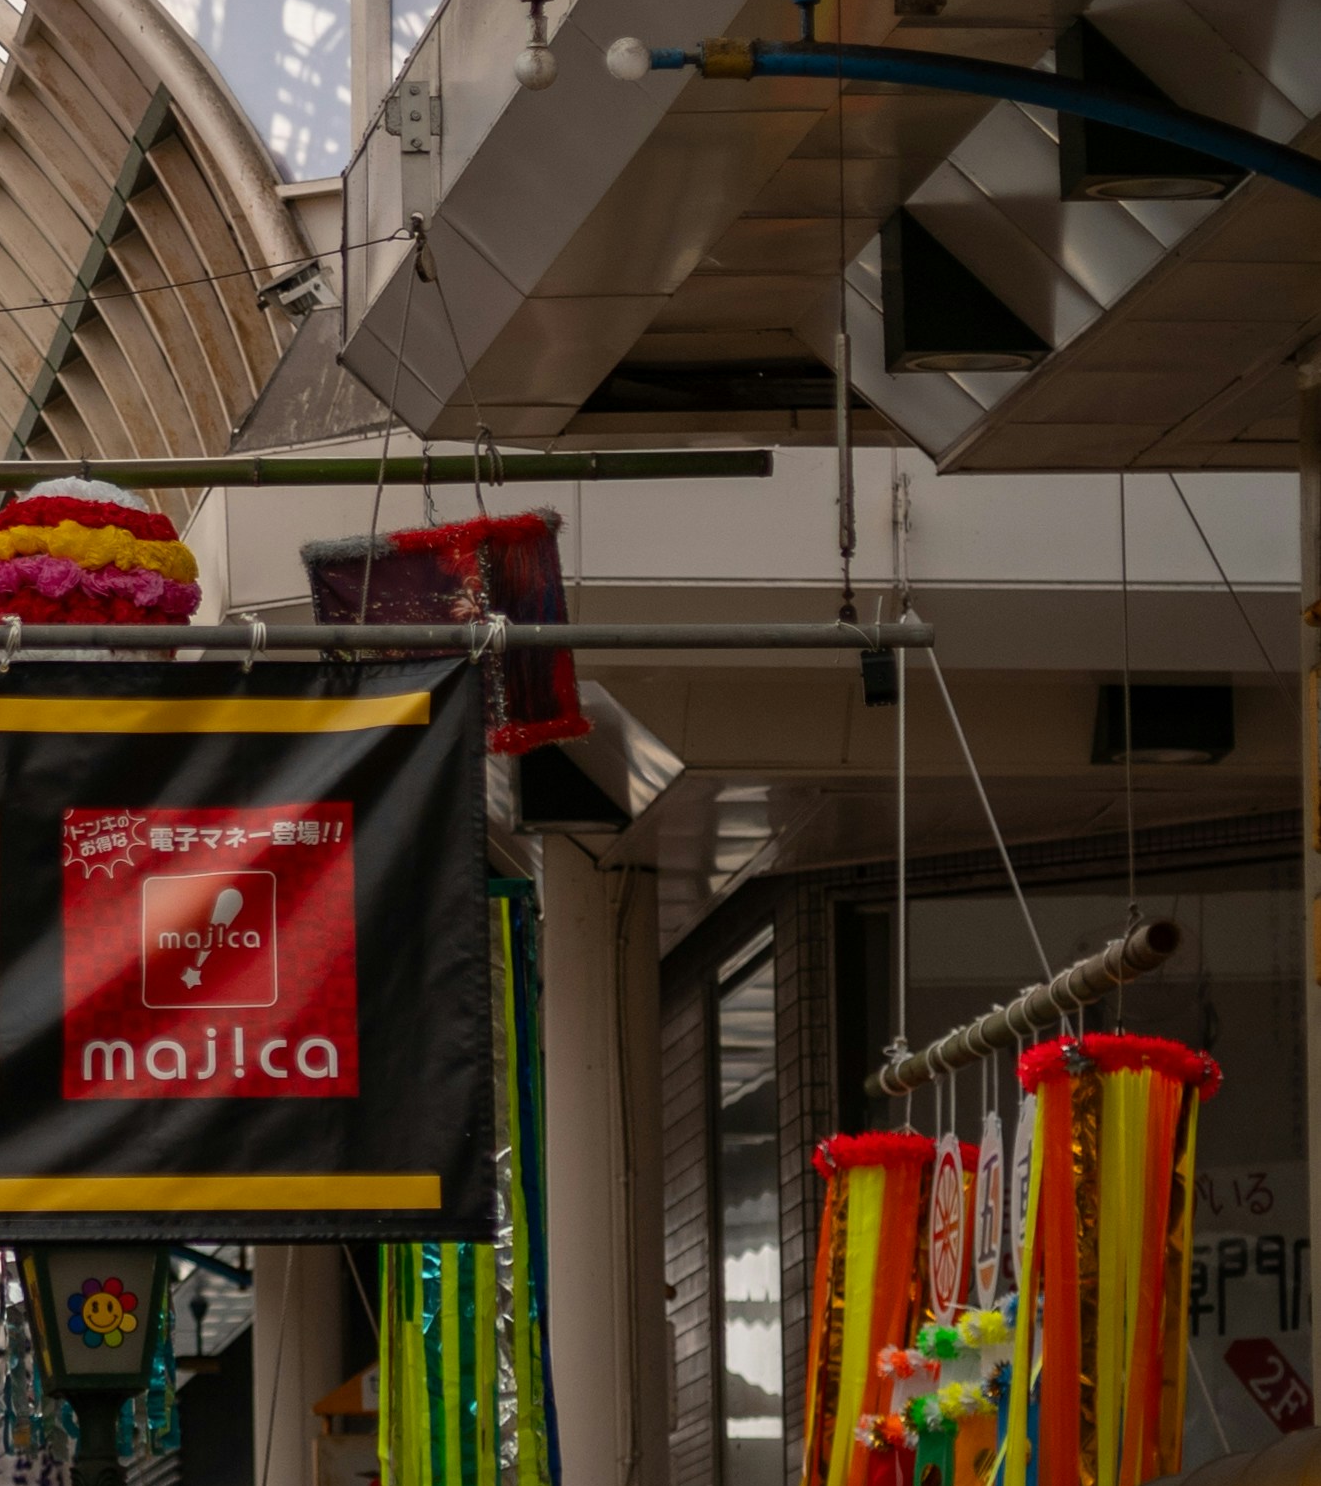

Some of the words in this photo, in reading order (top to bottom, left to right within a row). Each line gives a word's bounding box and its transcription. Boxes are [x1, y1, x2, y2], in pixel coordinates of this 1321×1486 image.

[69, 815, 130, 841] ドンキの
[79, 832, 129, 857] お得な
[1249, 1354, 1309, 1422] 2F
